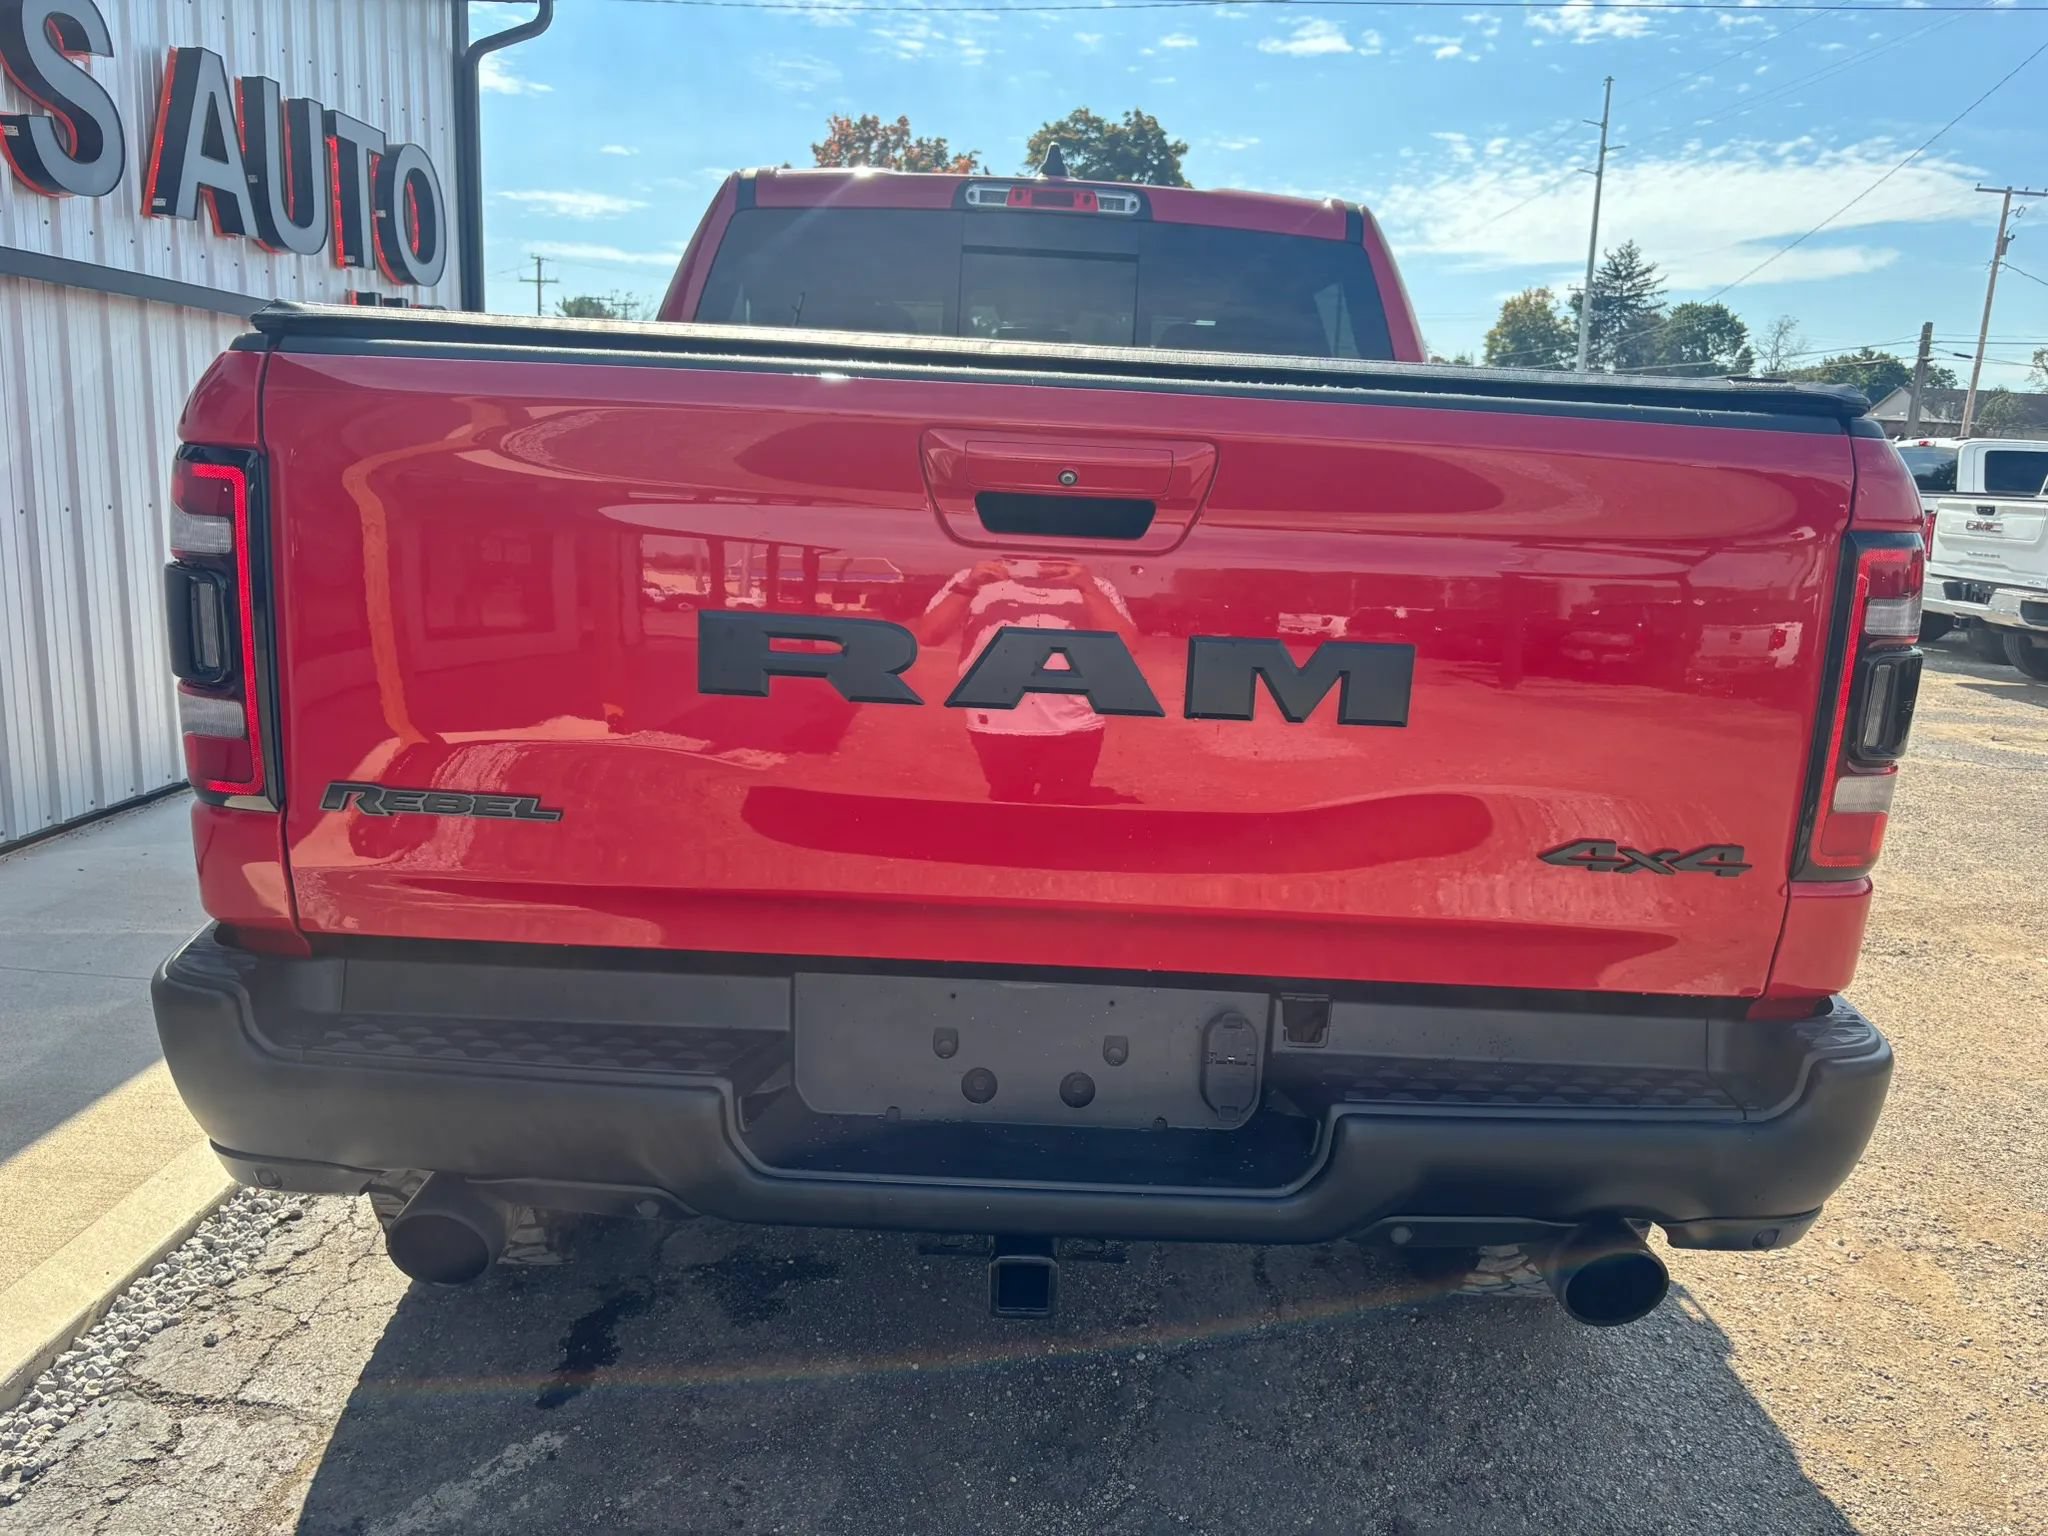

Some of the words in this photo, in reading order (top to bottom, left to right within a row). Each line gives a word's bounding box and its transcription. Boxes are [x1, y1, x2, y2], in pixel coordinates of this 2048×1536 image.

[148, 46, 446, 287] AUTO
[1966, 520, 2003, 533] GMC
[698, 609, 1416, 727] RAM
[319, 780, 563, 823] REBEL
